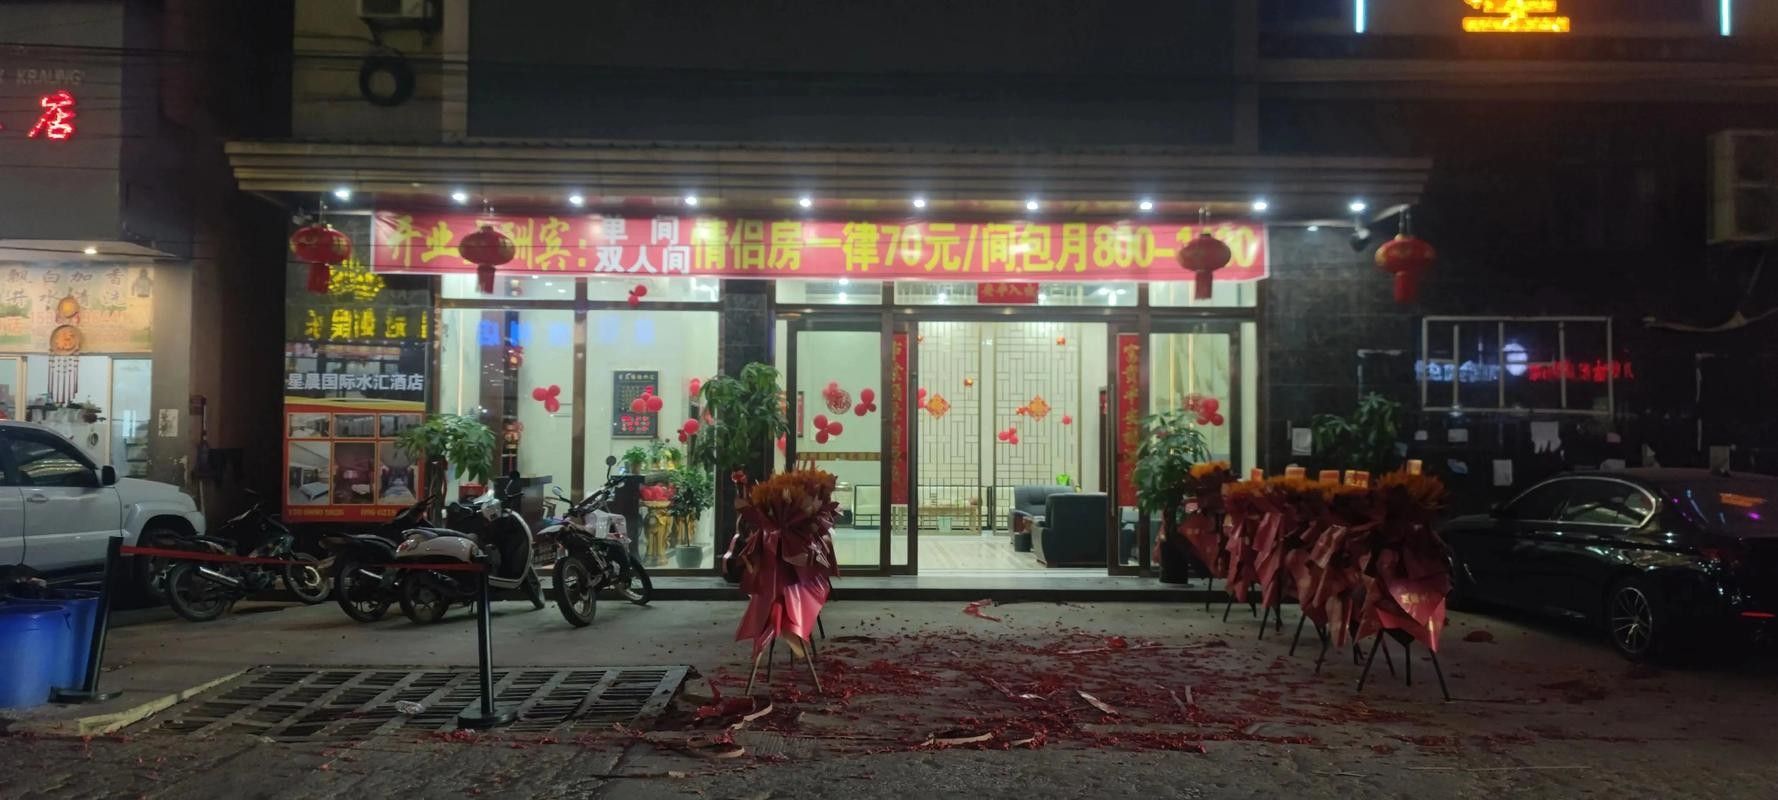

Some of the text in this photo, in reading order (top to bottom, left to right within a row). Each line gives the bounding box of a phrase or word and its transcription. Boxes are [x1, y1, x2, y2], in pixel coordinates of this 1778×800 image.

[594, 245, 691, 273] 双人间
[286, 373, 425, 391] 星晨国际水汇酒店
